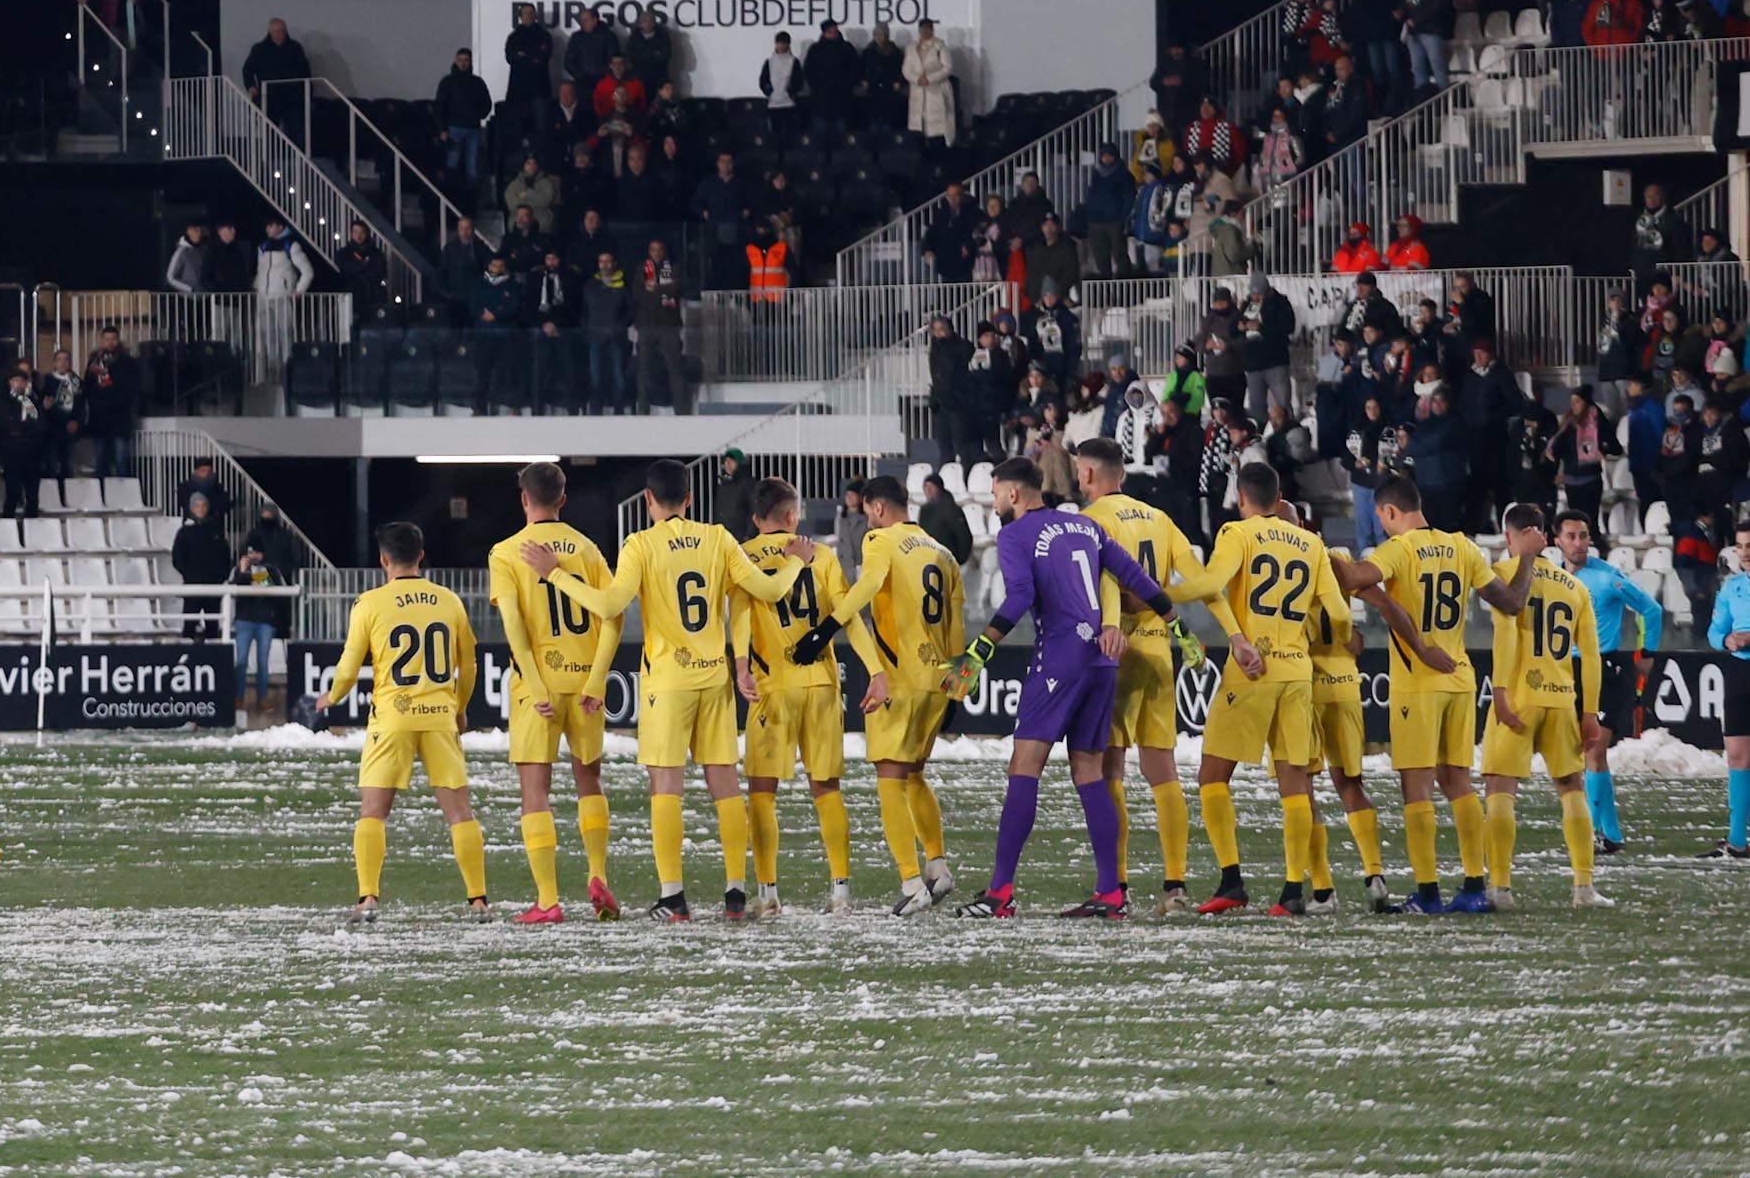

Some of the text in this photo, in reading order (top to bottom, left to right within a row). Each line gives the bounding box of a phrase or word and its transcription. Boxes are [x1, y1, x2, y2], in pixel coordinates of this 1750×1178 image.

[668, 537, 702, 552] ANDY
[1034, 522, 1064, 558] TOMÁS
[1416, 545, 1454, 561] MUSTO
[396, 593, 438, 608] JAIRO
[676, 571, 708, 633] 6
[762, 566, 820, 629] 14
[922, 564, 944, 625] 8
[1071, 550, 1100, 611] 1
[1249, 553, 1310, 622] 22
[1418, 571, 1462, 633] 18
[538, 573, 590, 637] 10
[1527, 597, 1573, 661] 16
[80, 653, 217, 696] Herrán
[390, 621, 452, 687] 20
[564, 662, 594, 673] riber
[691, 654, 725, 670] ribera
[1320, 674, 1354, 685] ribera
[82, 696, 217, 720] Construcciones
[410, 702, 450, 715] ribera
